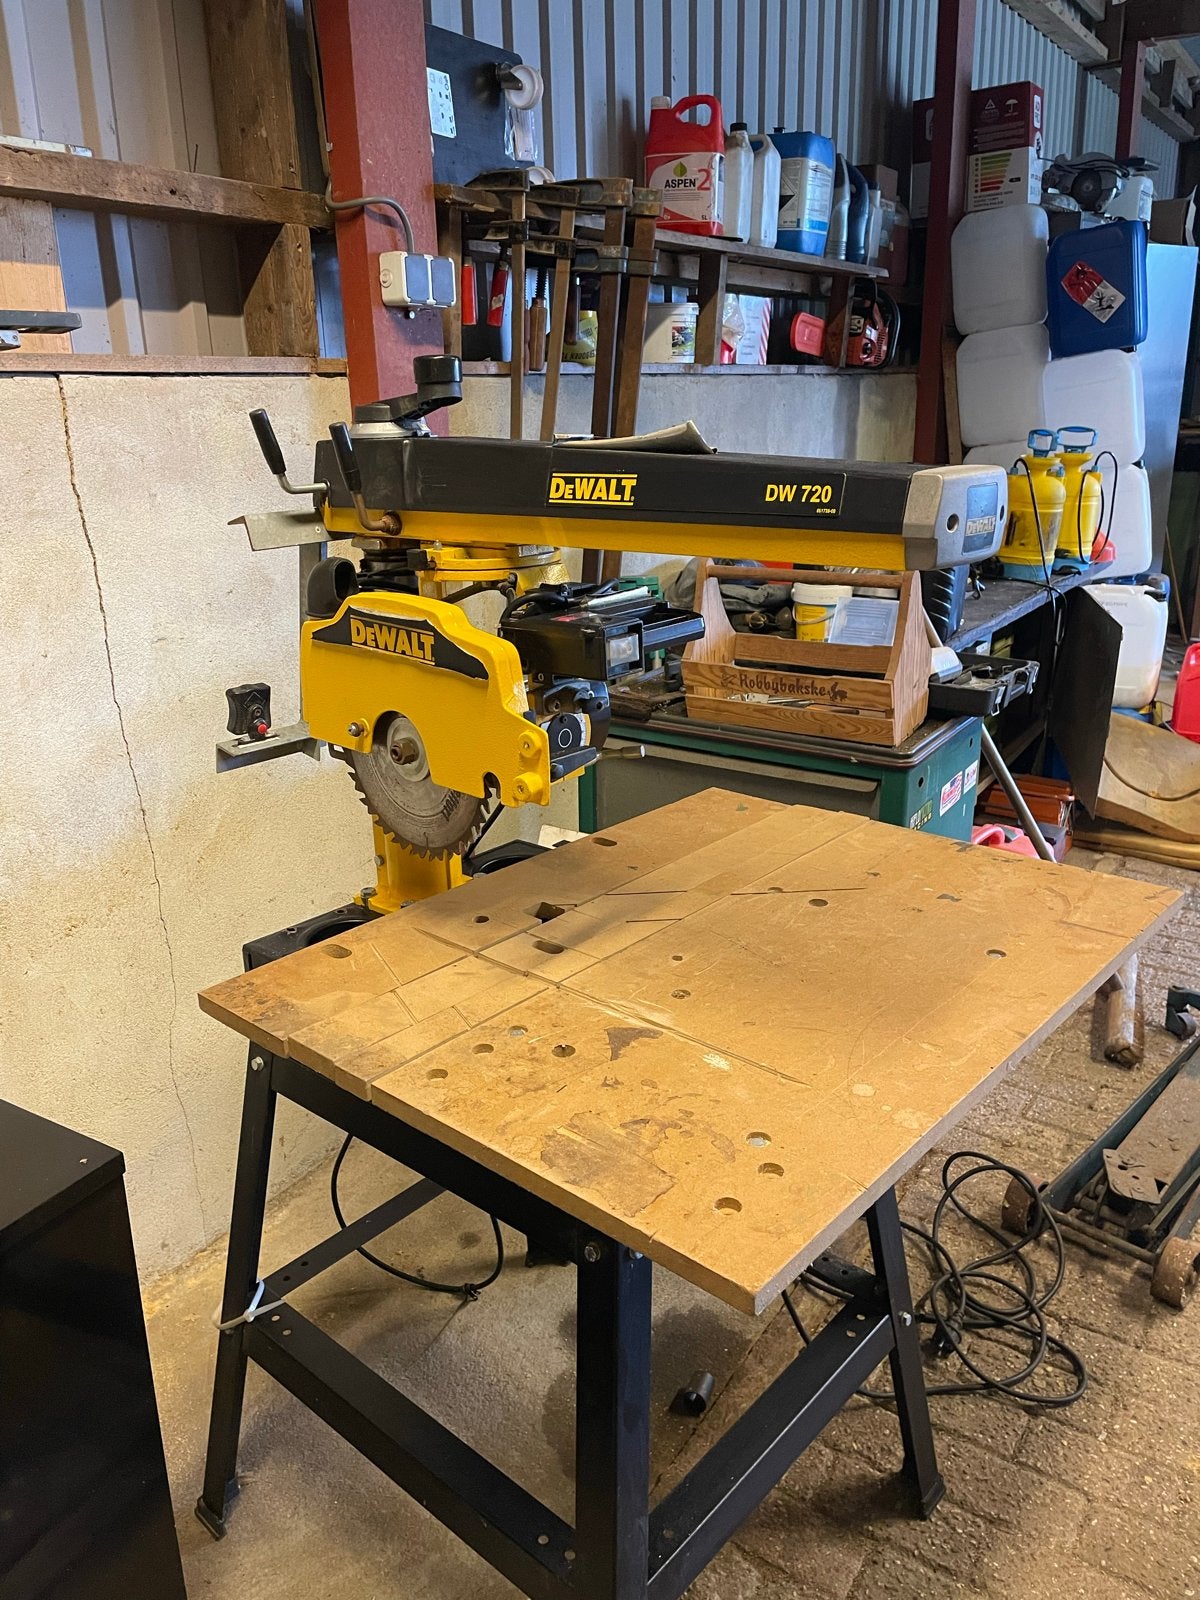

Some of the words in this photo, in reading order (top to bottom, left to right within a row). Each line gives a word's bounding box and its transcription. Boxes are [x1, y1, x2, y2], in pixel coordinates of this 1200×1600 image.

[664, 178, 696, 189] ASPEN
[697, 168, 711, 191] 2
[765, 484, 797, 502] DW
[801, 484, 832, 504] 720
[739, 673, 826, 696] Hobbybakske
